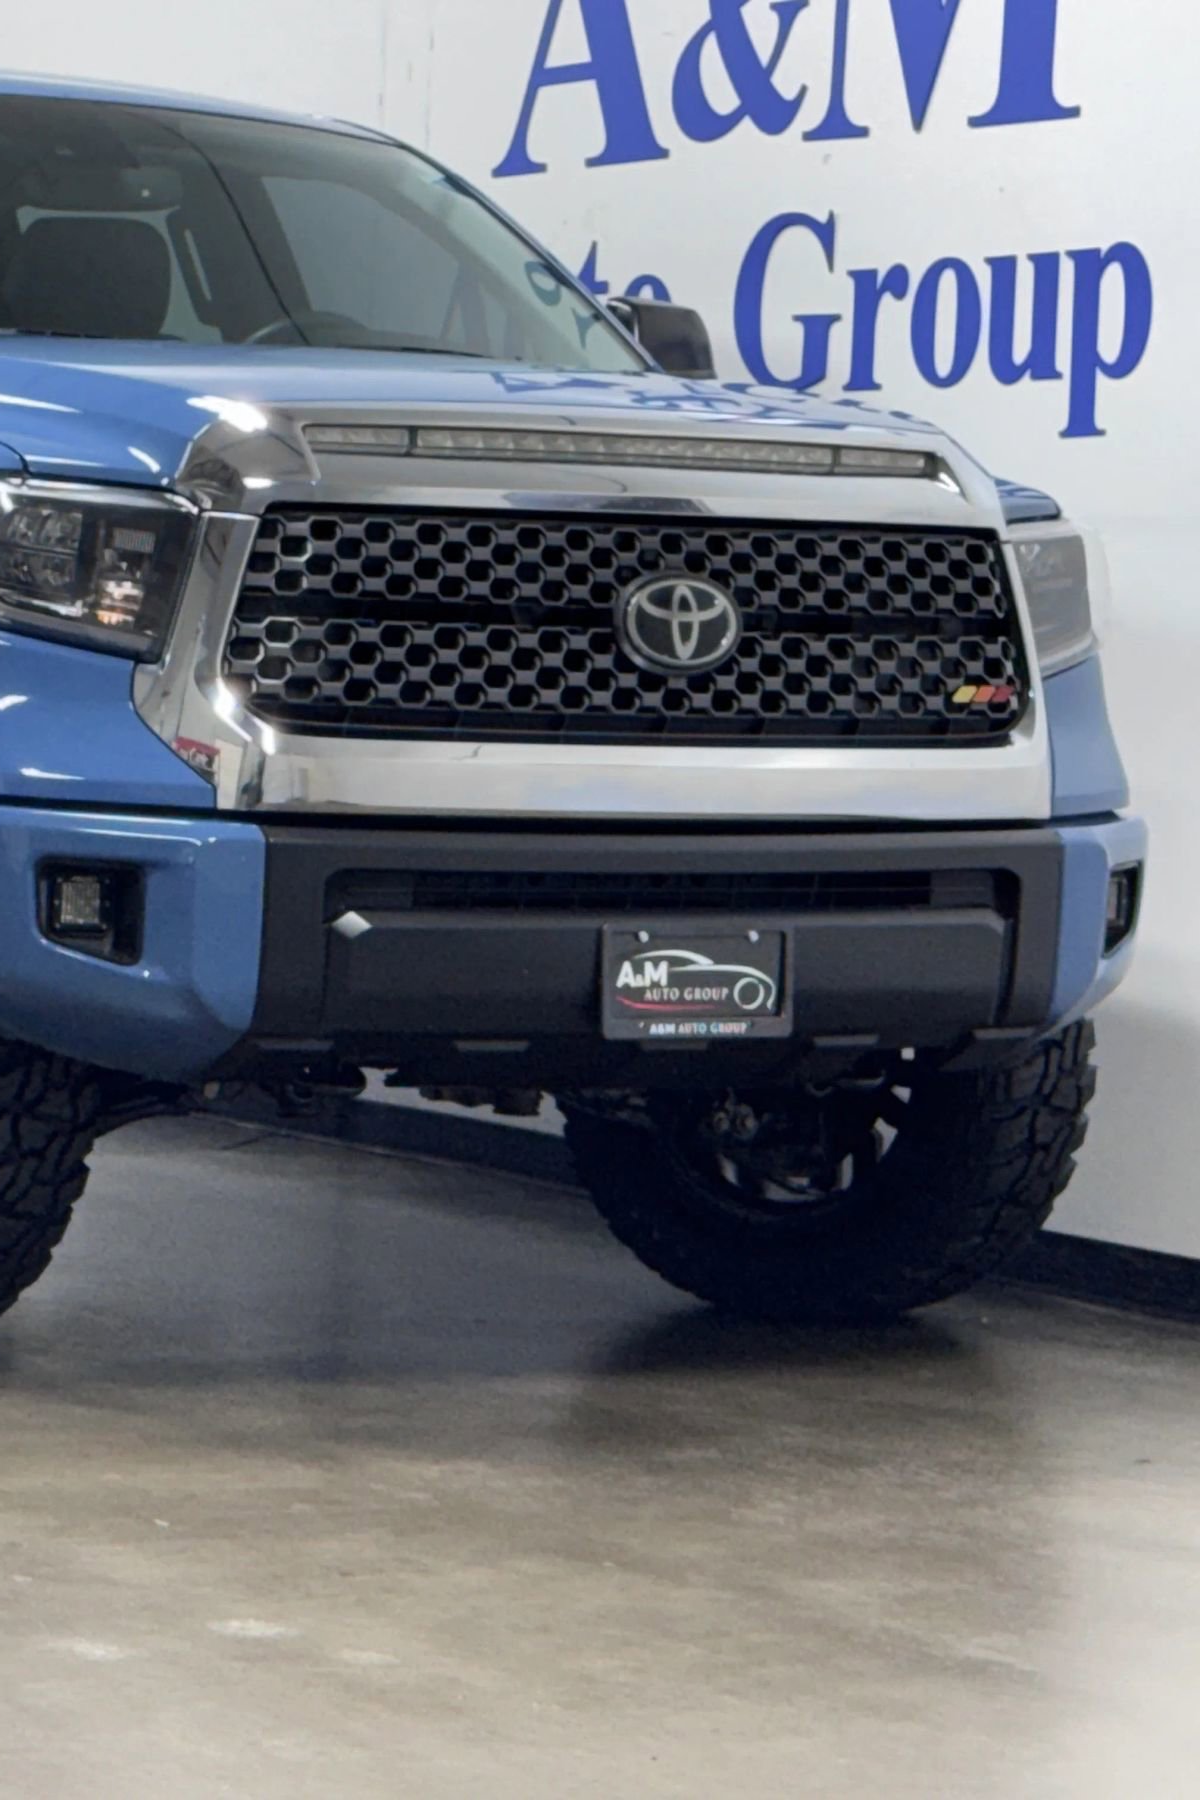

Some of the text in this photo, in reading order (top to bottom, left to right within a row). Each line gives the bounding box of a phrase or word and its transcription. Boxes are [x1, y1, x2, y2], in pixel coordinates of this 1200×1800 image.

[733, 210, 1154, 438] Group
[615, 960, 669, 989] A&M
[644, 986, 729, 1001] AUTO GROUP
[649, 1022, 748, 1035] A&M AUTO GROUP
